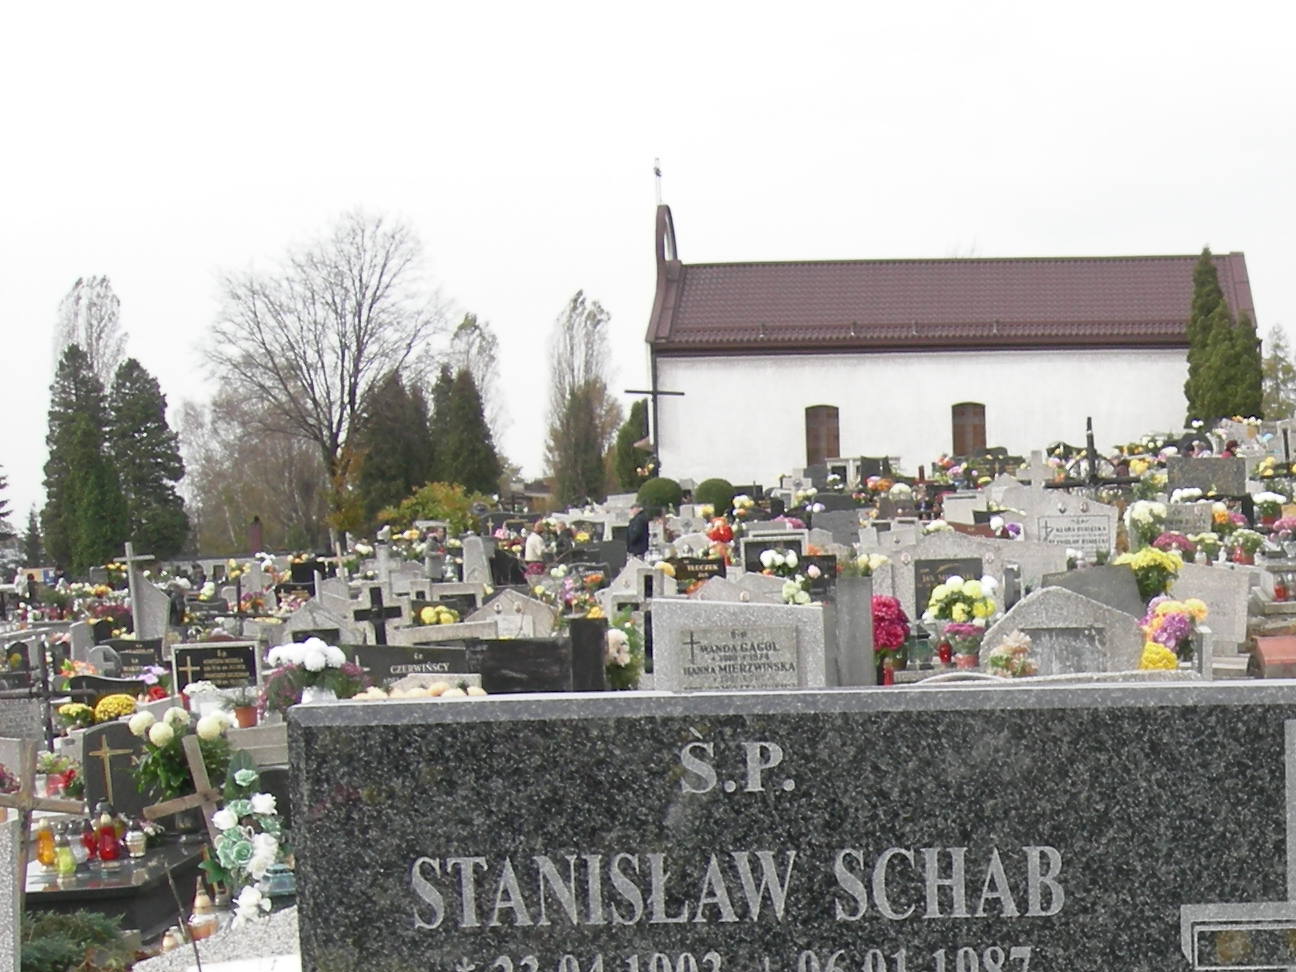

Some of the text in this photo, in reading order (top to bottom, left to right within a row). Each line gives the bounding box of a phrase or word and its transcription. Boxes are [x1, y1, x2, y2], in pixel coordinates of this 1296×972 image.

[701, 643, 738, 654] WANDA
[390, 661, 450, 674] CZERWIŃSCY
[410, 846, 1065, 930] STANISŁAW SCHAB
